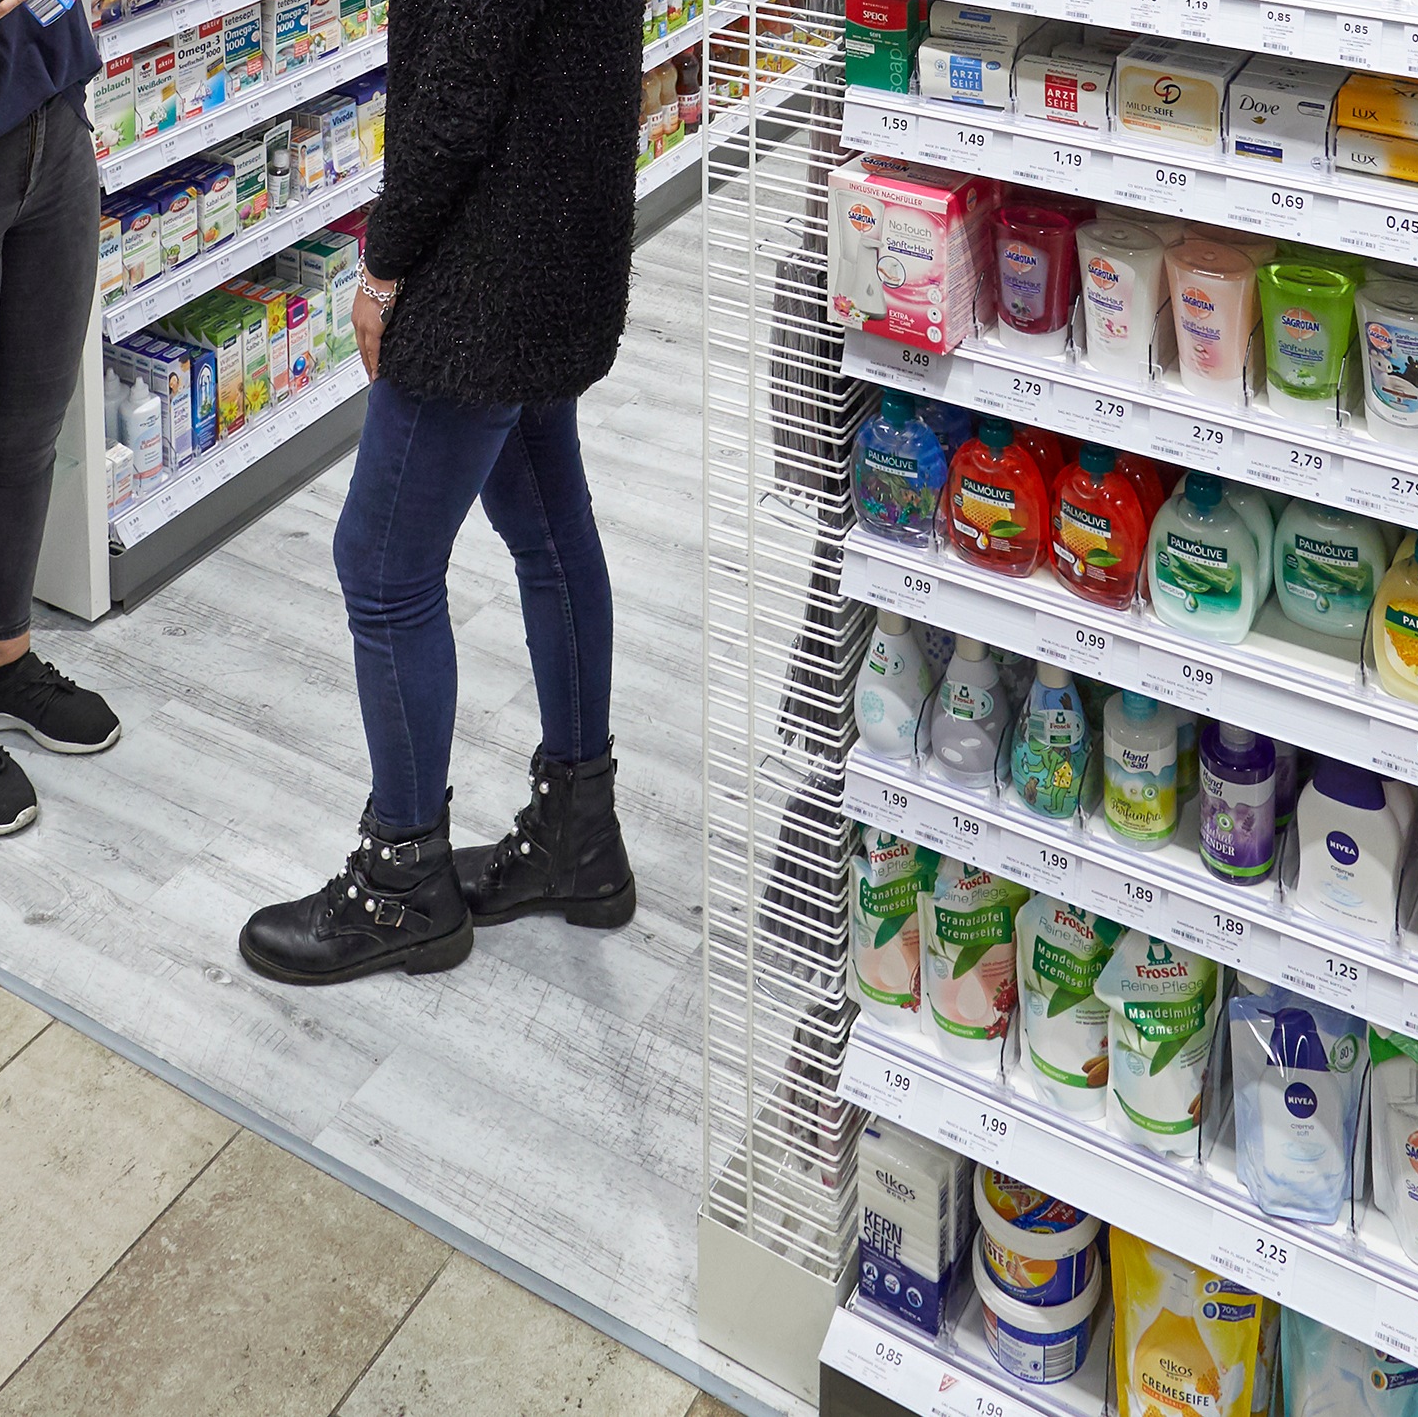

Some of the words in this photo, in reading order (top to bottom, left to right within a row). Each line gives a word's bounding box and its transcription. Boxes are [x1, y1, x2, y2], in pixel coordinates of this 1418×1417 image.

[276, 4, 309, 23] Omega-3
[1185, 0, 1208, 10] 1,19
[224, 21, 259, 41] Omega-3
[277, 20, 295, 32] 1000
[178, 36, 221, 60] Omega-3
[110, 56, 131, 70] aktiv
[952, 69, 980, 81] ARZT
[951, 79, 980, 92] SEIFE
[1125, 100, 1152, 114] MILDE
[1153, 105, 1174, 117] SEIFE
[236, 152, 261, 169] tetesept
[849, 182, 879, 199] INKLUSIVE
[881, 190, 923, 207] NACHFÜLLER
[889, 219, 903, 230] No
[904, 222, 932, 237] Touch
[963, 479, 1012, 503] PALMOLIVE
[1329, 842, 1356, 856] NIVEA
[939, 910, 1004, 936] Granatapfel
[941, 926, 1003, 942] Cremeseife
[1135, 962, 1189, 979] Frosch
[1129, 1002, 1203, 1020] Mandelmilch
[884, 1070, 910, 1090] 1,99
[864, 1206, 902, 1242] KERN
[1142, 1372, 1210, 1407] CREMESEIFE
